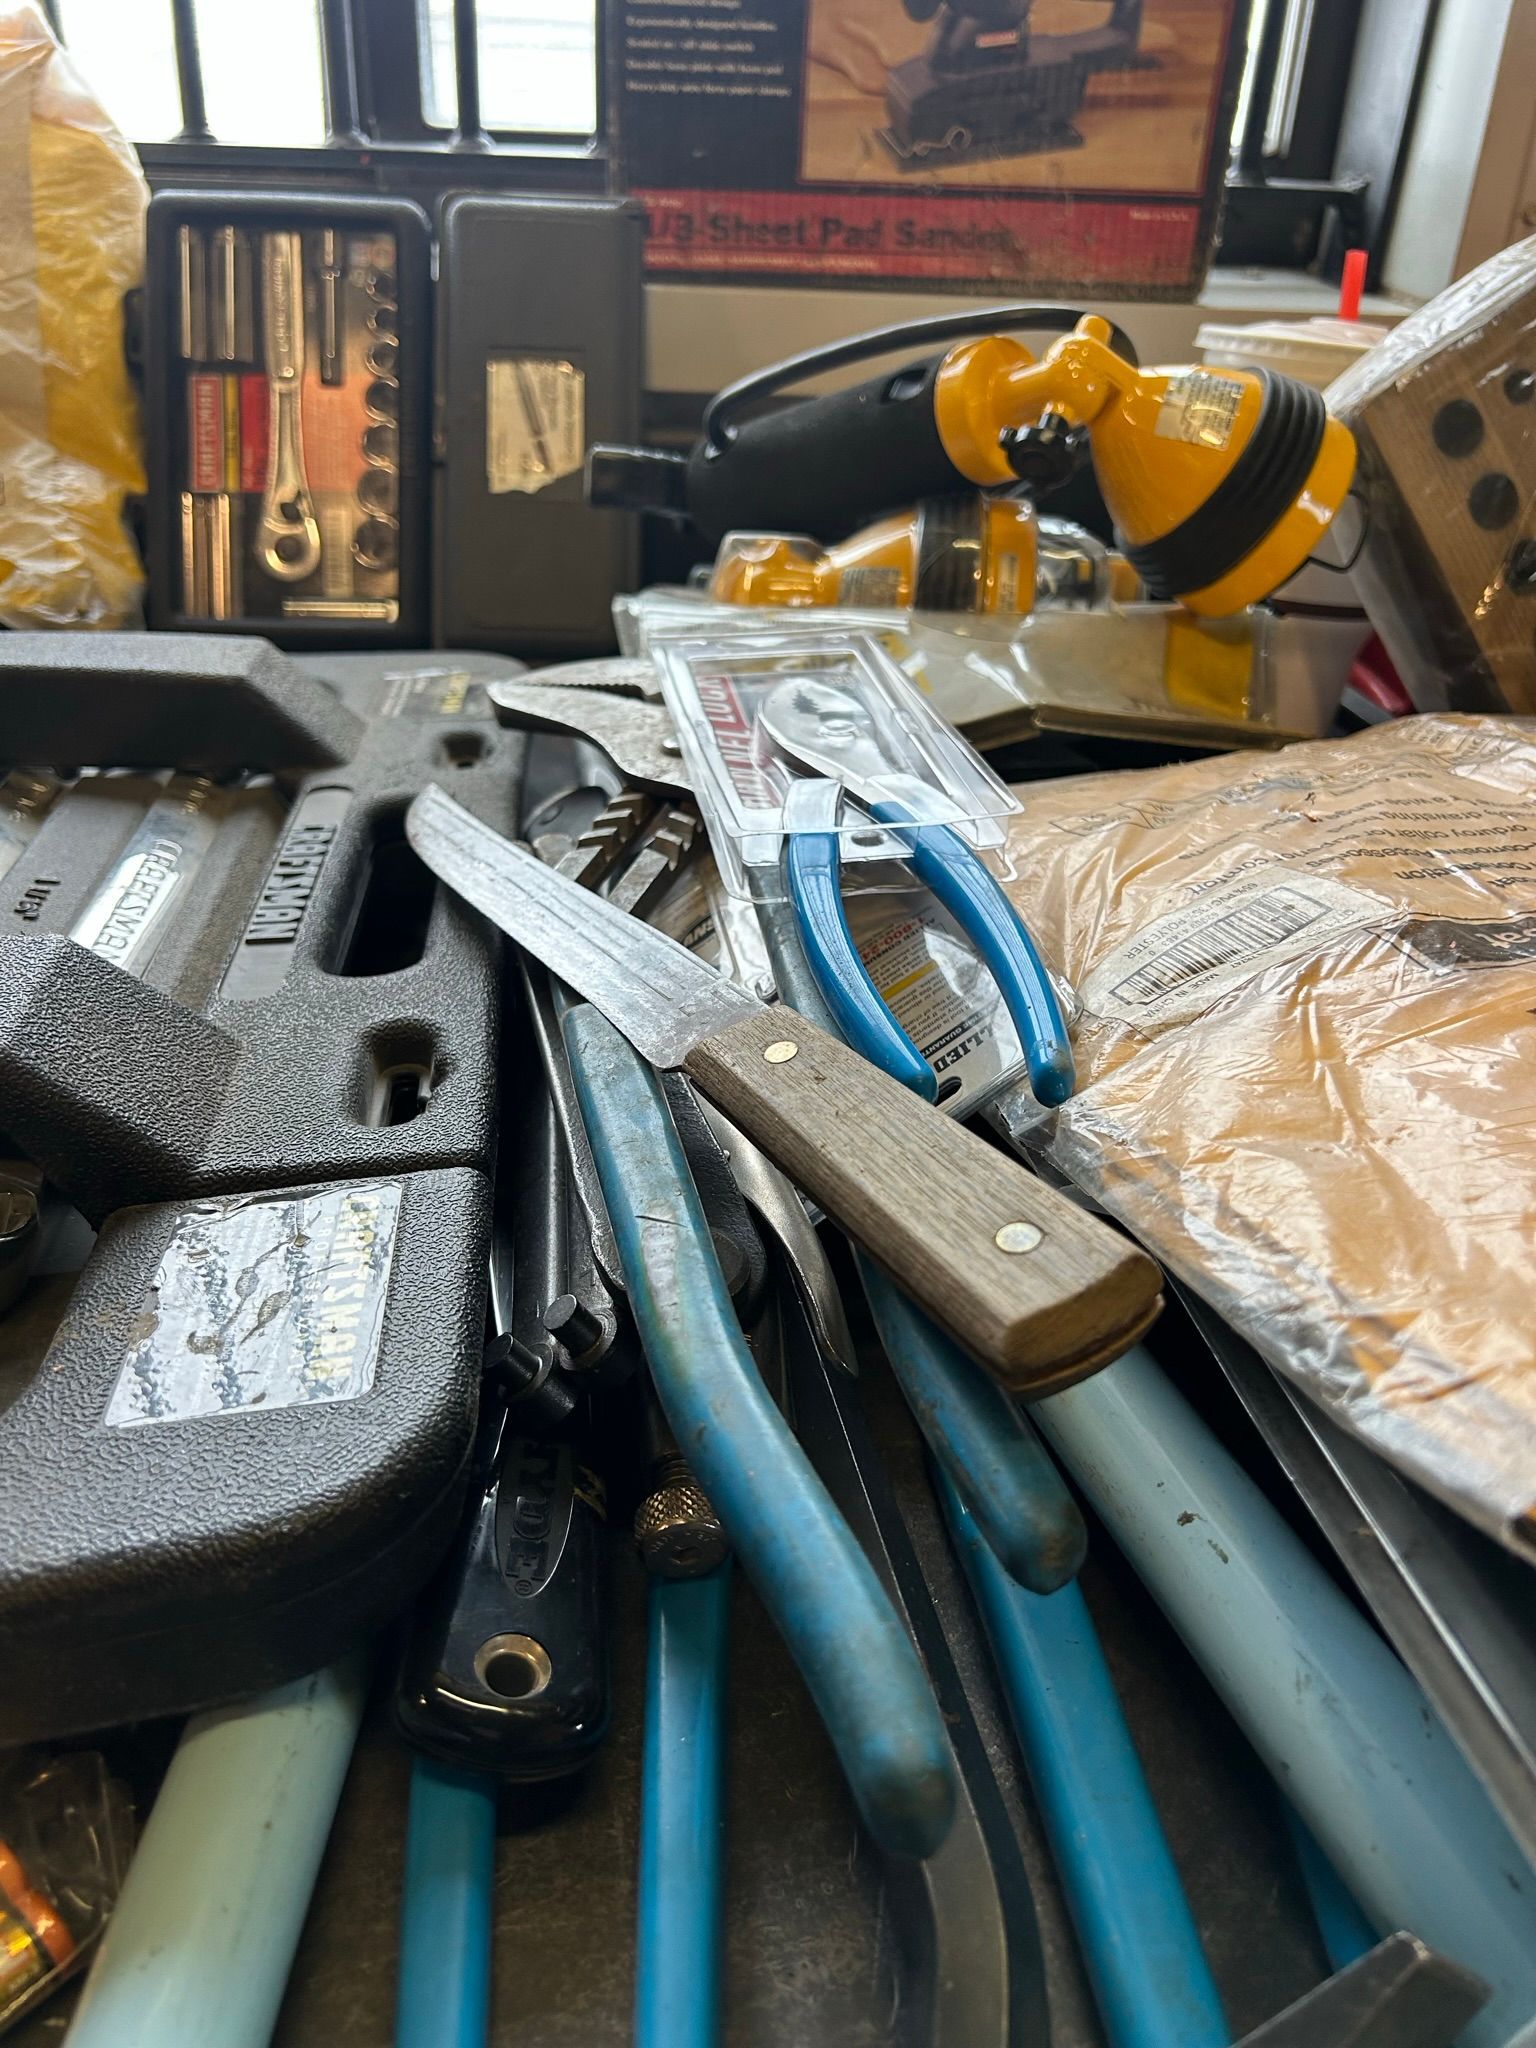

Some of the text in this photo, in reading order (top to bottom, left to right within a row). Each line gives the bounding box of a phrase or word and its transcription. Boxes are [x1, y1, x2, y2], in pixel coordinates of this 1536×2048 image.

[819, 215, 884, 248] Pad
[197, 382, 218, 487] CRAFTSMAN
[1452, 822, 1528, 841] orduroy
[246, 825, 337, 944] CRAFTSMAN
[1189, 856, 1270, 896] comfort
[1188, 968, 1219, 991] MADE
[1141, 995, 1175, 1020] CHINA
[932, 1022, 995, 1073] LLIED
[302, 1195, 381, 1378] CRAFTSMAN
